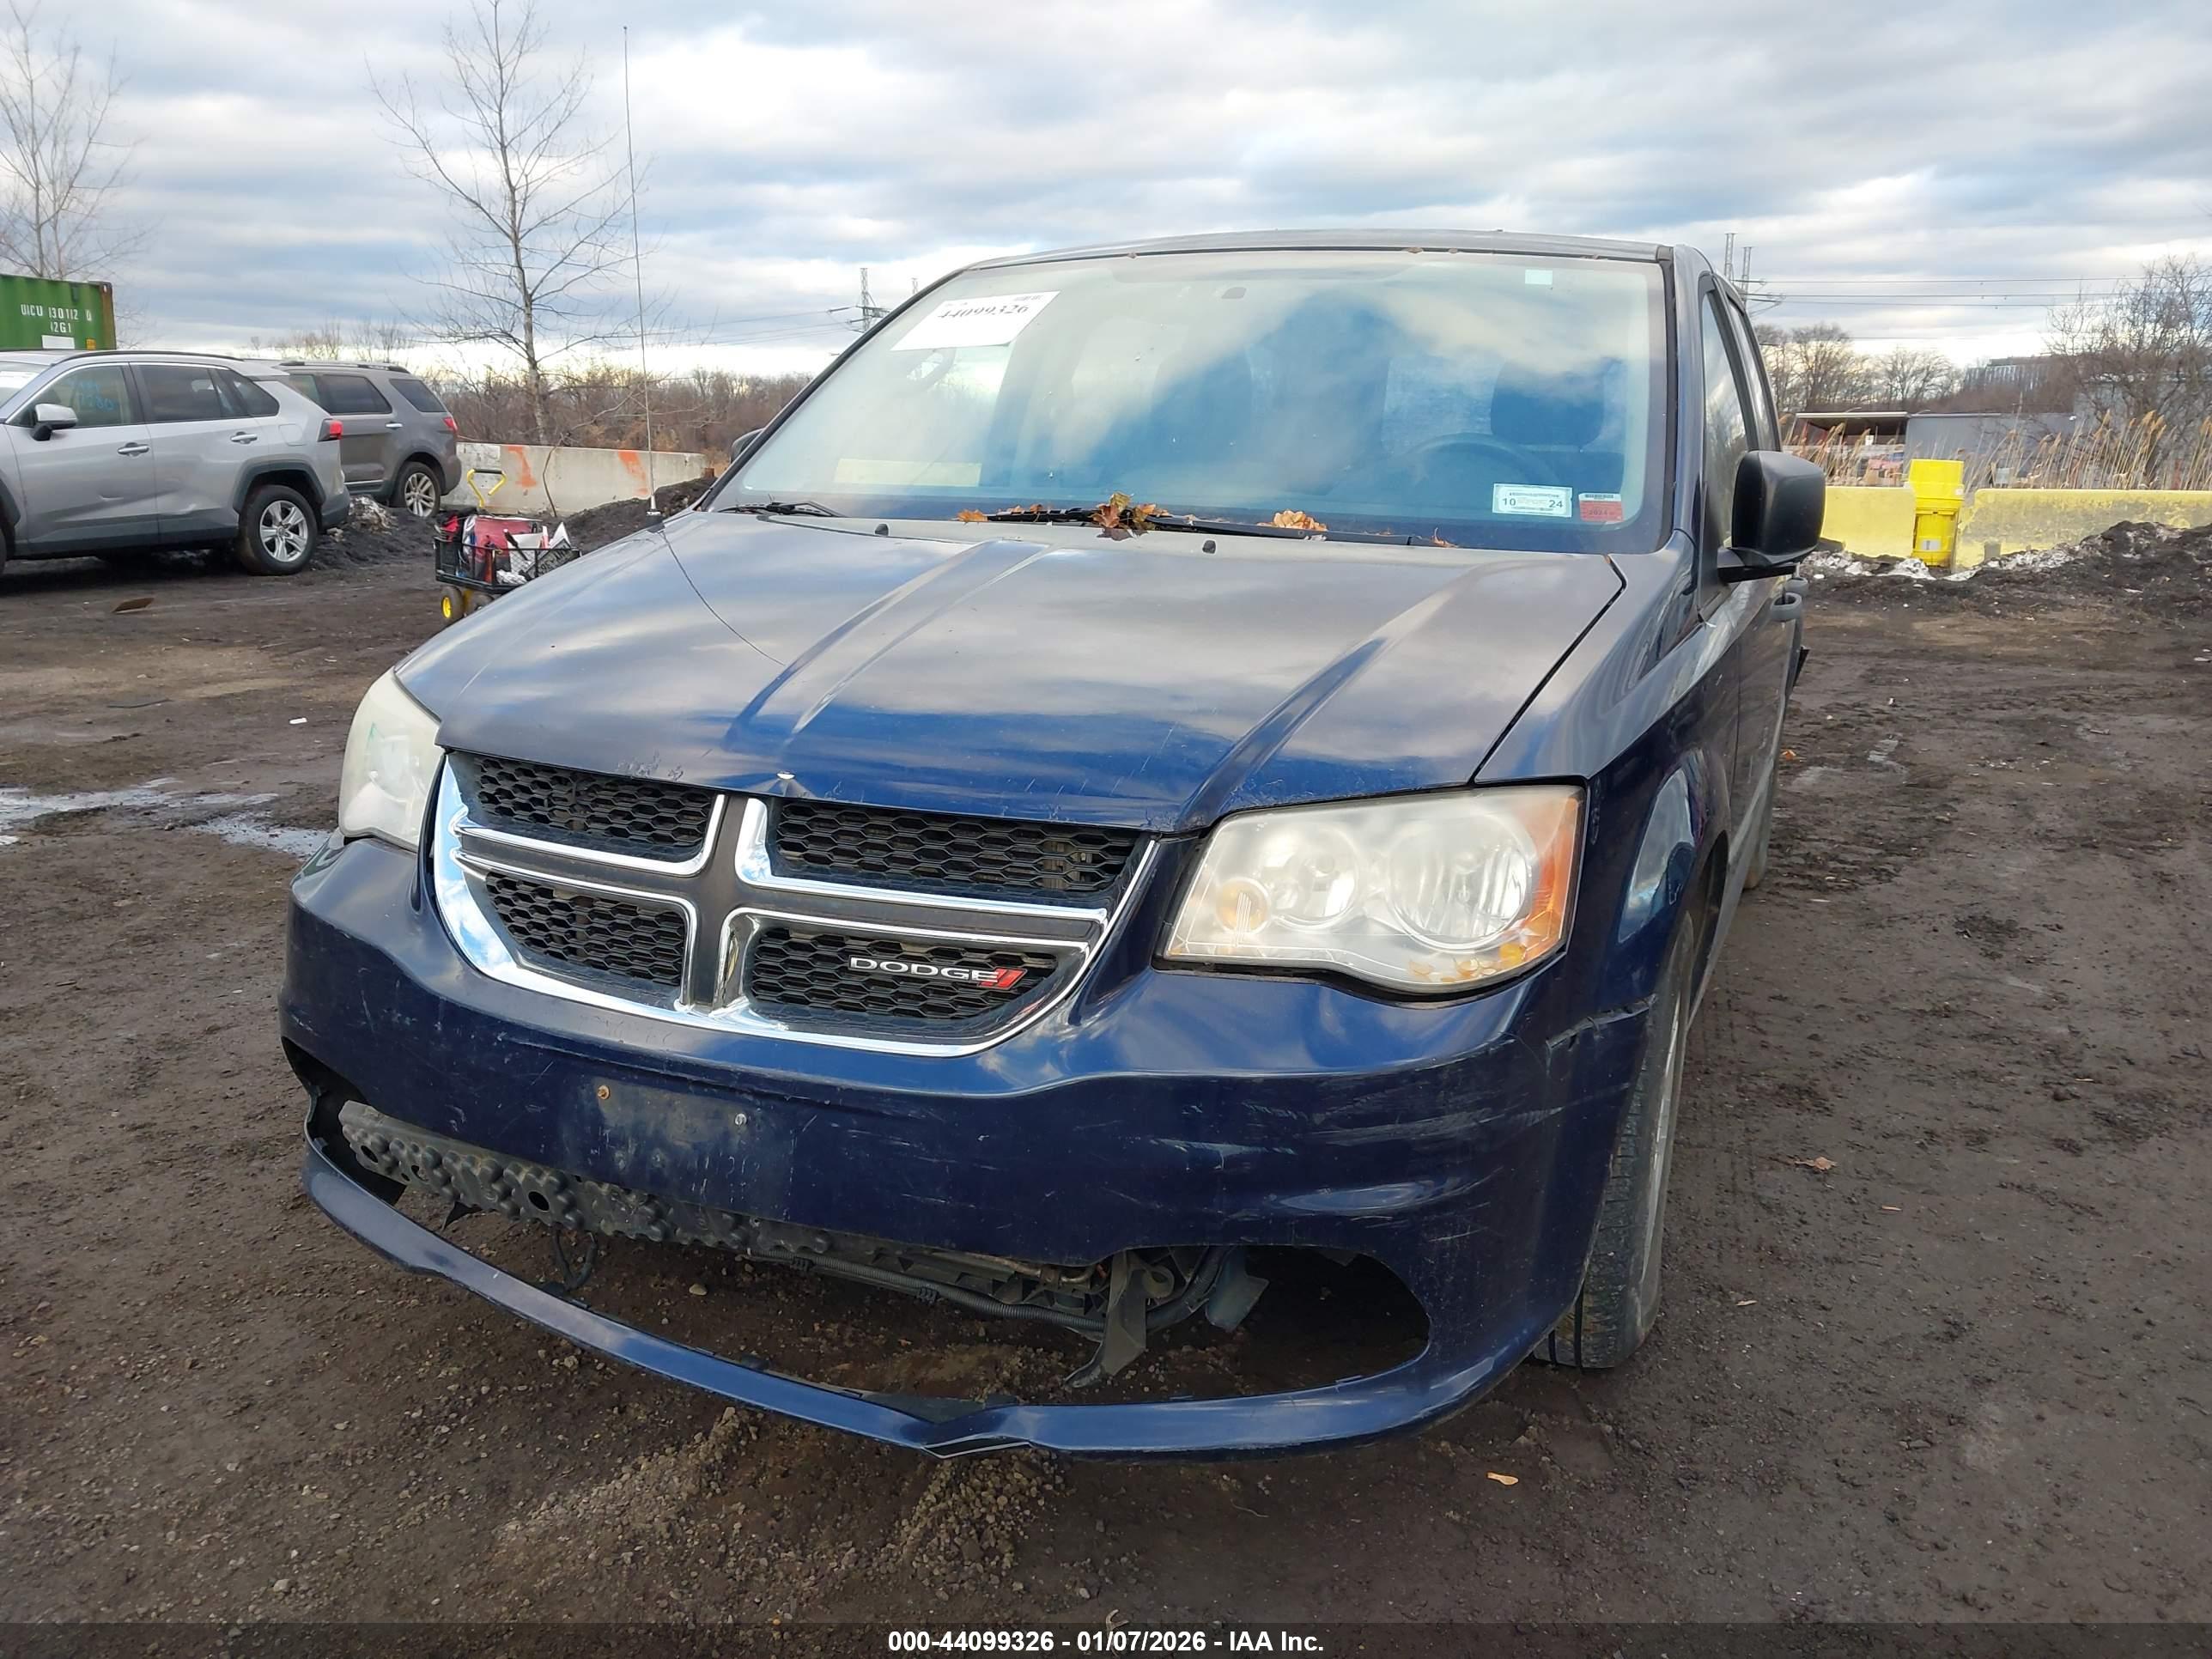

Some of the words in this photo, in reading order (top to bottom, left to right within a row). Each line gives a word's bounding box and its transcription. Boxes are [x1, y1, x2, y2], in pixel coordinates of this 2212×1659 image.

[20, 304, 43, 317] UICU
[1502, 497, 1516, 506] 10
[1548, 499, 1564, 508] 24
[850, 957, 1000, 983] DODGE
